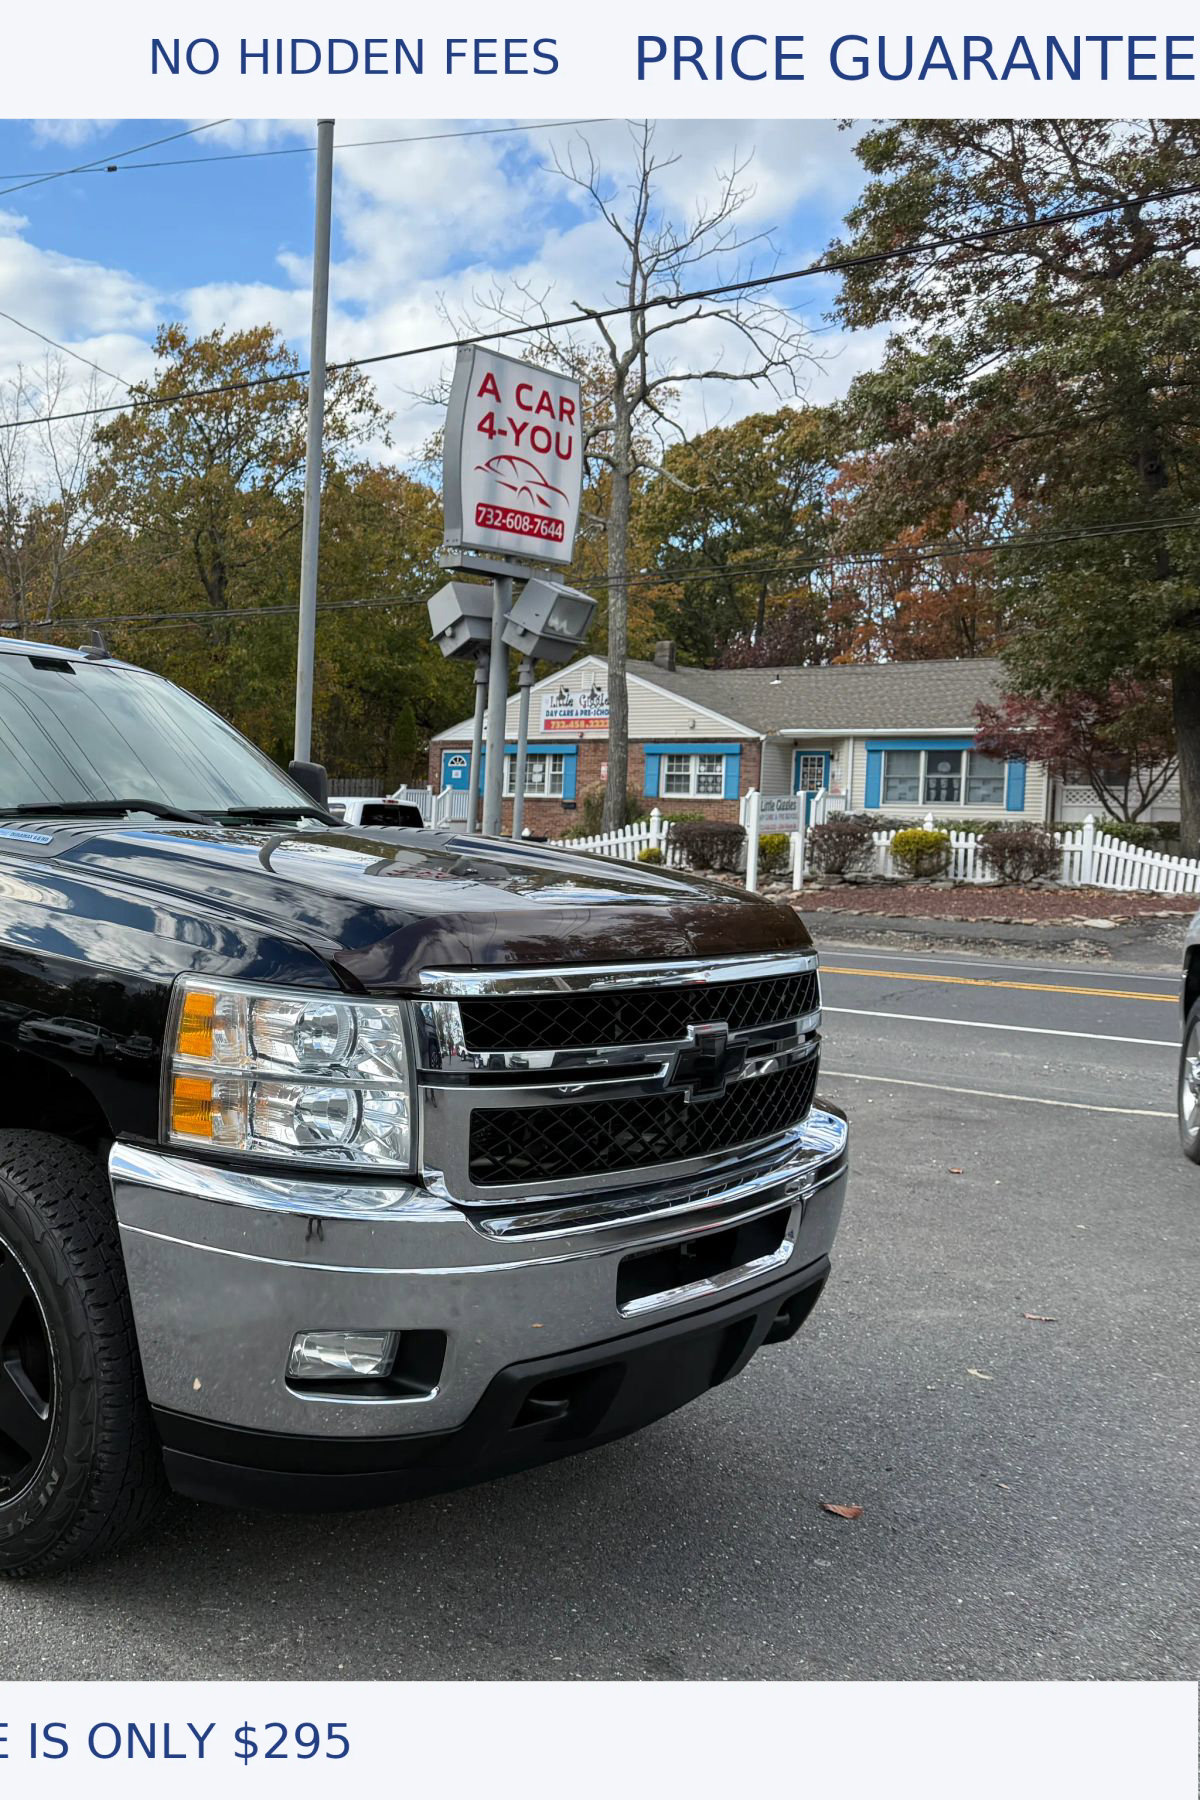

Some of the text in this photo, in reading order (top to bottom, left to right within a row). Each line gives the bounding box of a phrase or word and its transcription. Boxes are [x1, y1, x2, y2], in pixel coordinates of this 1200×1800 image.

[477, 372, 575, 425] A CAR
[477, 411, 573, 460] 4-YOU
[477, 506, 563, 538] 732-608-7644
[579, 693, 609, 709] Giggle
[580, 709, 608, 717] PRE-SCHO
